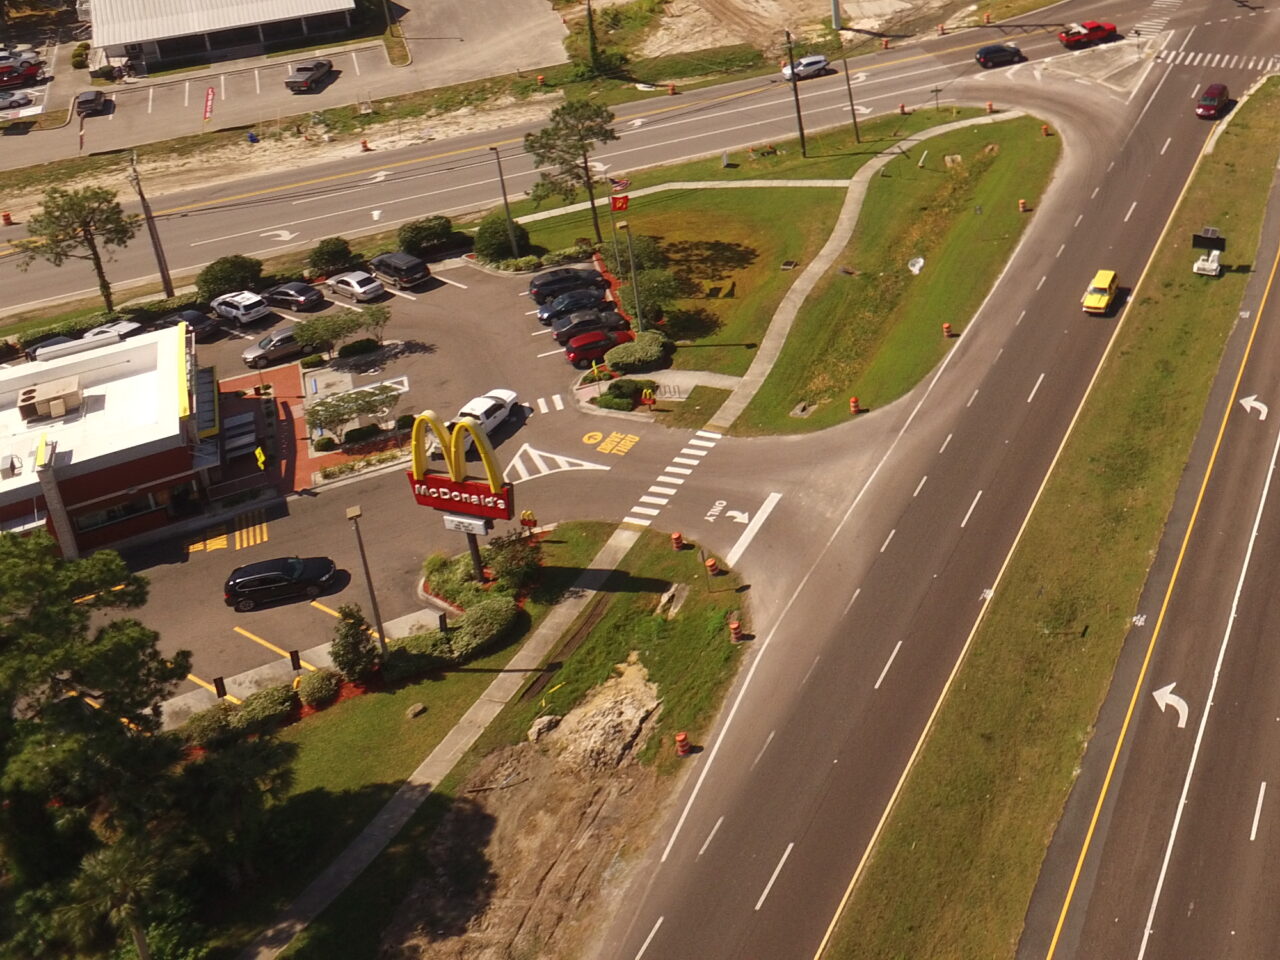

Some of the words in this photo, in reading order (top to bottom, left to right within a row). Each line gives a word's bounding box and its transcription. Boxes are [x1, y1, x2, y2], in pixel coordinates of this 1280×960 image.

[596, 431, 626, 454] DRIVE
[611, 434, 640, 456] THRU
[414, 483, 506, 509] McDonald's
[704, 499, 728, 523] ONLY
